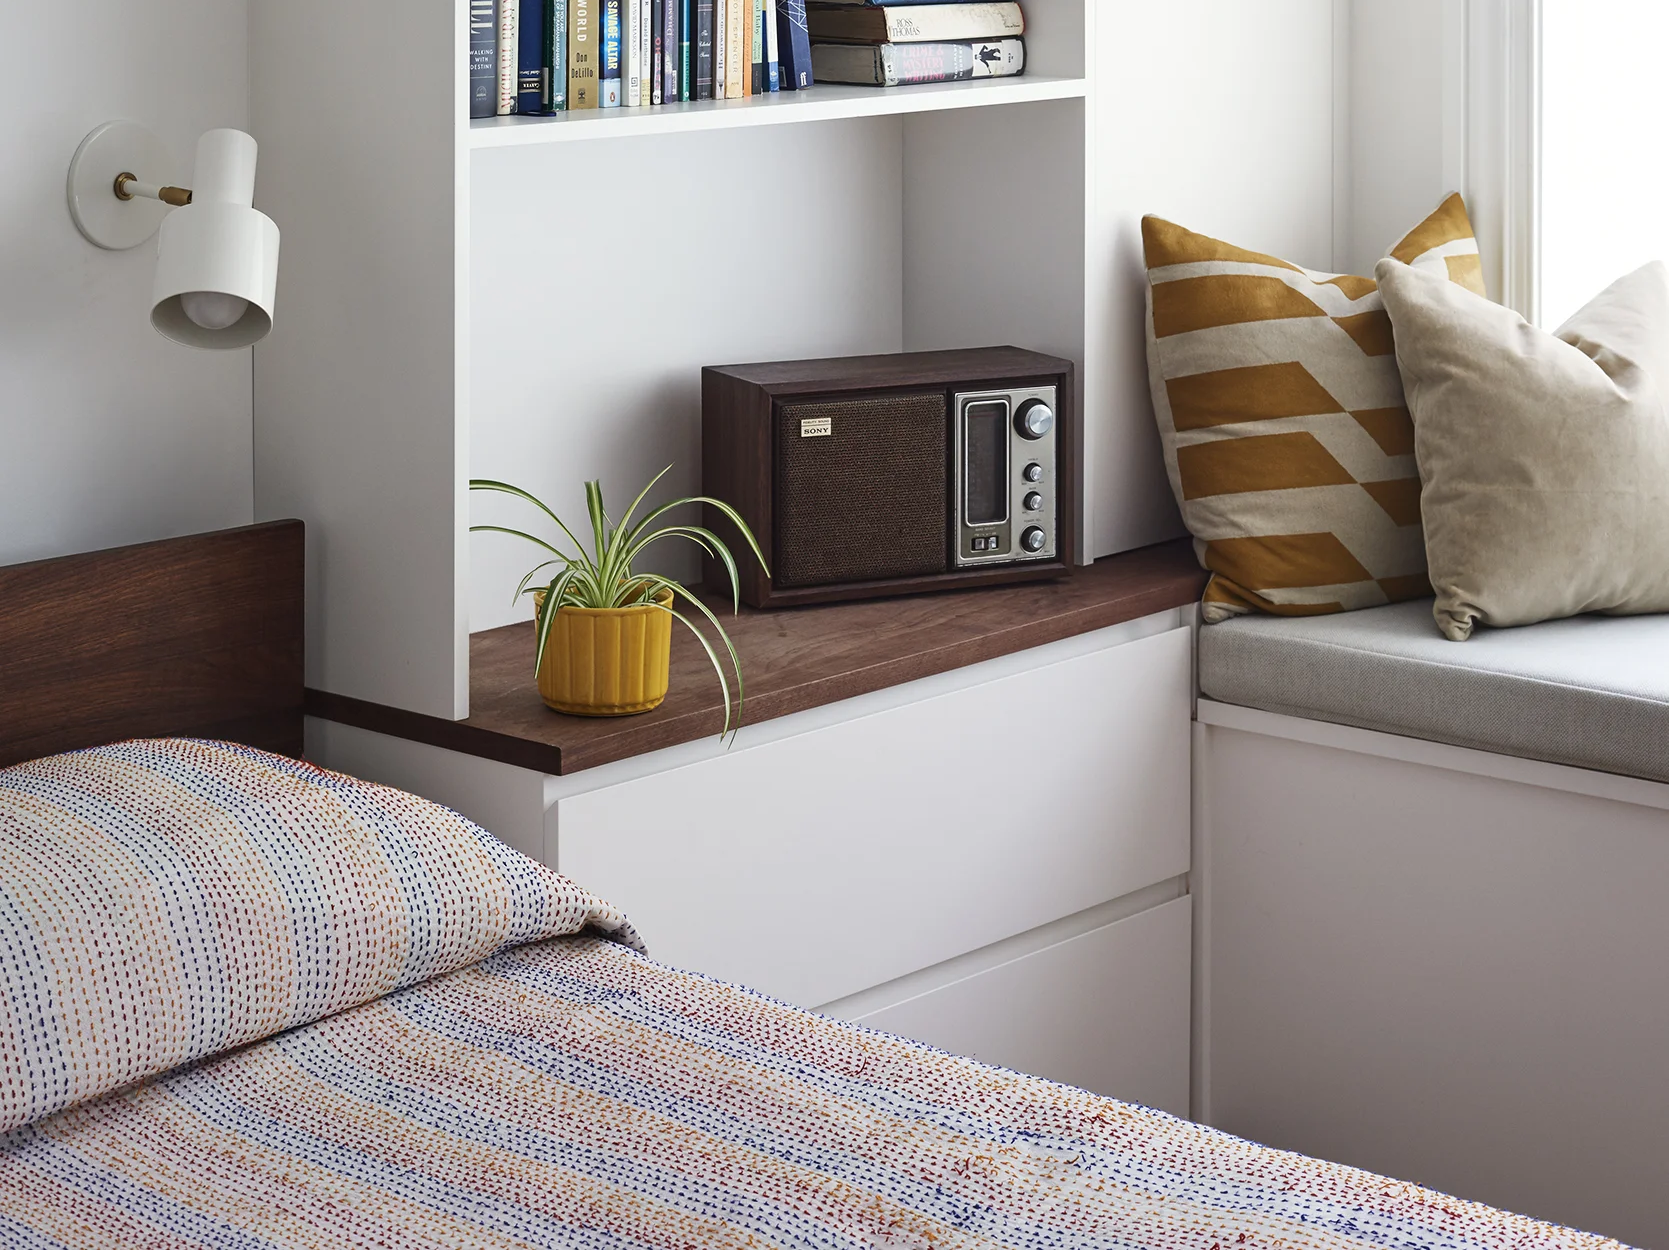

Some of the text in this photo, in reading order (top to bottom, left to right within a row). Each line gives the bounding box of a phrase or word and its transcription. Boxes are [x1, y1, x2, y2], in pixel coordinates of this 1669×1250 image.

[607, 1, 618, 39] SAVAGE
[753, 15, 762, 36] Baby
[895, 17, 914, 28] ROSS
[891, 26, 921, 37] THOMAS
[575, 52, 588, 63] Don
[607, 40, 618, 70] ALTAR
[571, 68, 593, 79] DeLillo
[804, 427, 829, 435] SONY
